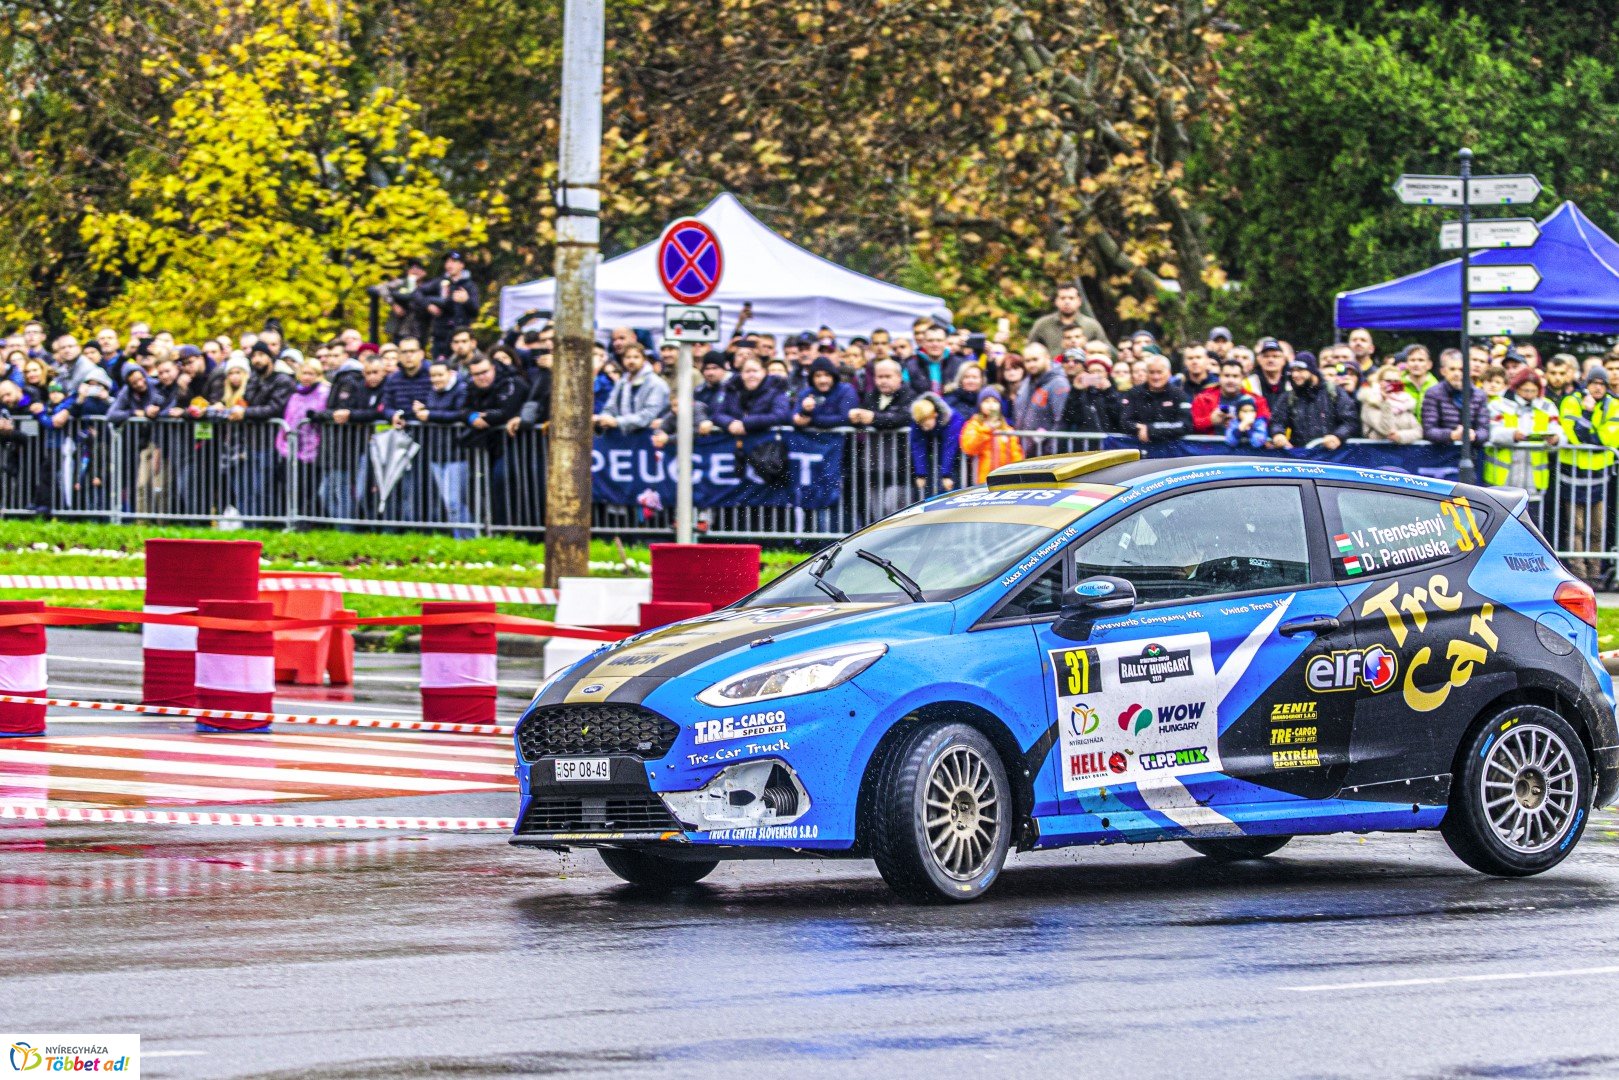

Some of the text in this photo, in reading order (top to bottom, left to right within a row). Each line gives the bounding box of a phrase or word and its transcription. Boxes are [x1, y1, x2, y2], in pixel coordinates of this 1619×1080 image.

[590, 449, 823, 486] PEUGET
[1253, 464, 1326, 474] Tre-Car Truck
[1356, 470, 1400, 482] Tre-Car
[1403, 476, 1429, 487] Plus
[1118, 489, 1141, 504] Truck
[1141, 481, 1165, 494] Center
[1165, 471, 1205, 485] Slovensko
[1351, 513, 1446, 549] V. Trencsényi
[1440, 496, 1485, 552] 37
[1001, 527, 1079, 587] Maxx Truck Hungary Kft.
[1361, 538, 1451, 571] D. Pannuska
[1140, 615, 1187, 625] Company
[1187, 610, 1204, 620] Kft.
[1220, 606, 1250, 616] United
[1248, 602, 1273, 611] Trend
[1361, 574, 1463, 648] Tre
[1121, 656, 1189, 678] RALLY HUNGARY
[1403, 602, 1499, 712] Car
[1064, 650, 1090, 695] 37
[1157, 702, 1206, 724] WOW
[1271, 701, 1318, 715] ZENIT
[694, 710, 786, 745] TRE-CARGO
[742, 724, 785, 736] SPED KFT
[1159, 721, 1199, 733] HUNGARY
[1271, 727, 1317, 744] TRE-CARGO
[687, 739, 791, 765] Tre-Car Truck
[1069, 736, 1104, 746] NYÍREGYHÁZA
[1070, 751, 1107, 776] HELL
[1272, 747, 1318, 761] EXTRÉM
[563, 761, 607, 778] SP 08-49
[708, 825, 818, 841] TRUCK CENTER SLOVENSKO S.R.O
